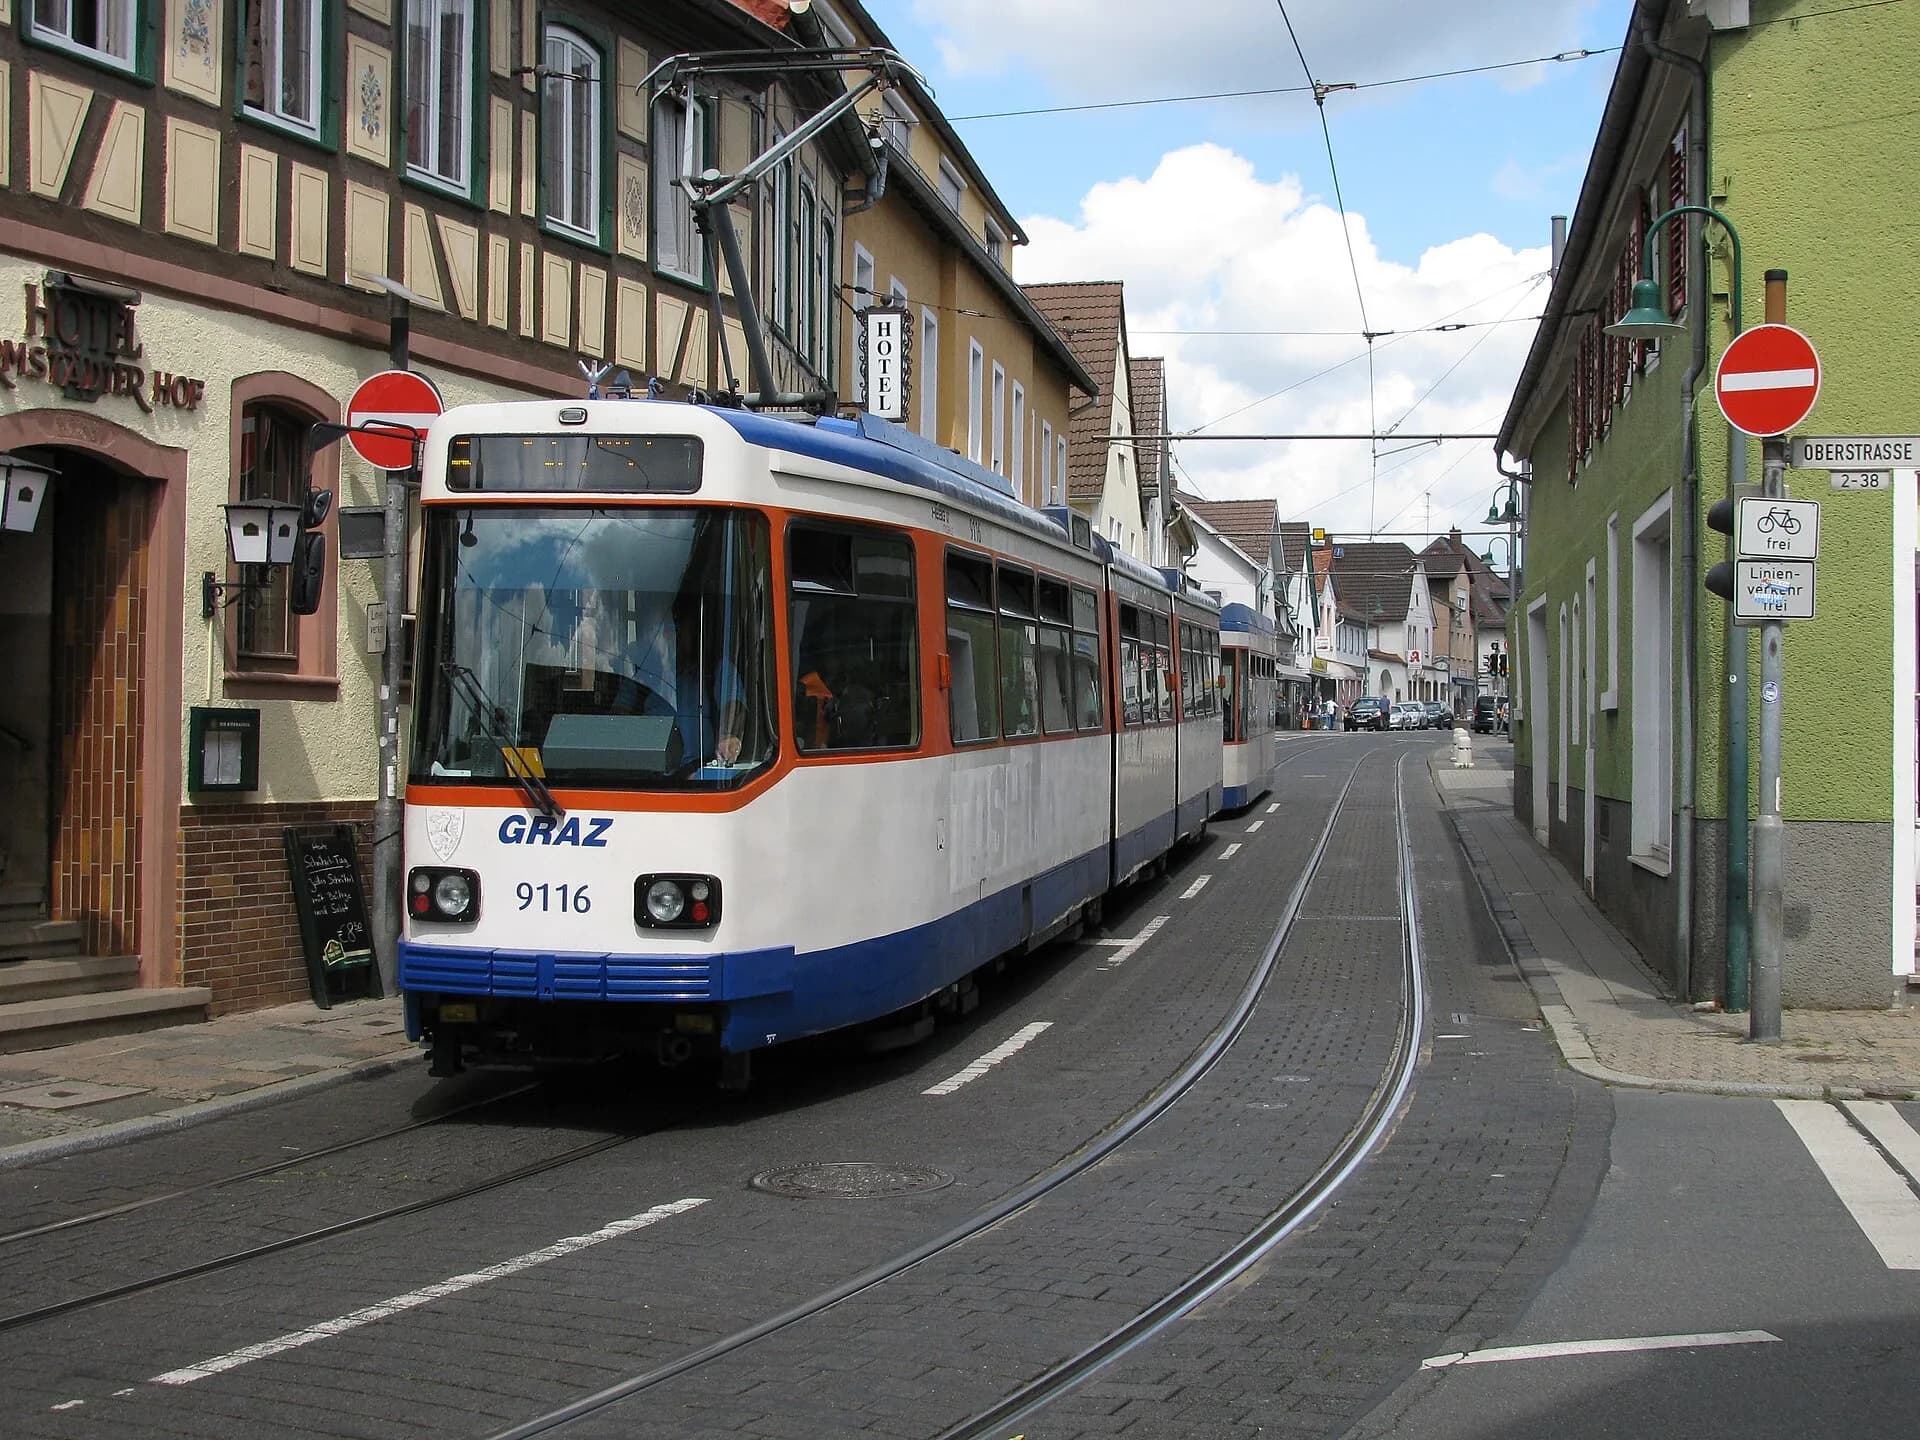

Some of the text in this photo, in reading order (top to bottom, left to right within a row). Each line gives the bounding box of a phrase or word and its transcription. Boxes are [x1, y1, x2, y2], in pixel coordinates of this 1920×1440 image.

[25, 283, 143, 359] HOTEL
[877, 321, 893, 411] HOTEL
[152, 371, 205, 411] HOF
[1804, 443, 1913, 461] OBERSTRASSE
[1841, 473, 1880, 488] 2-38
[1766, 537, 1792, 551] frei
[1750, 567, 1801, 580] Linien-
[498, 814, 614, 847] GRAZ
[516, 882, 591, 914] 9116
